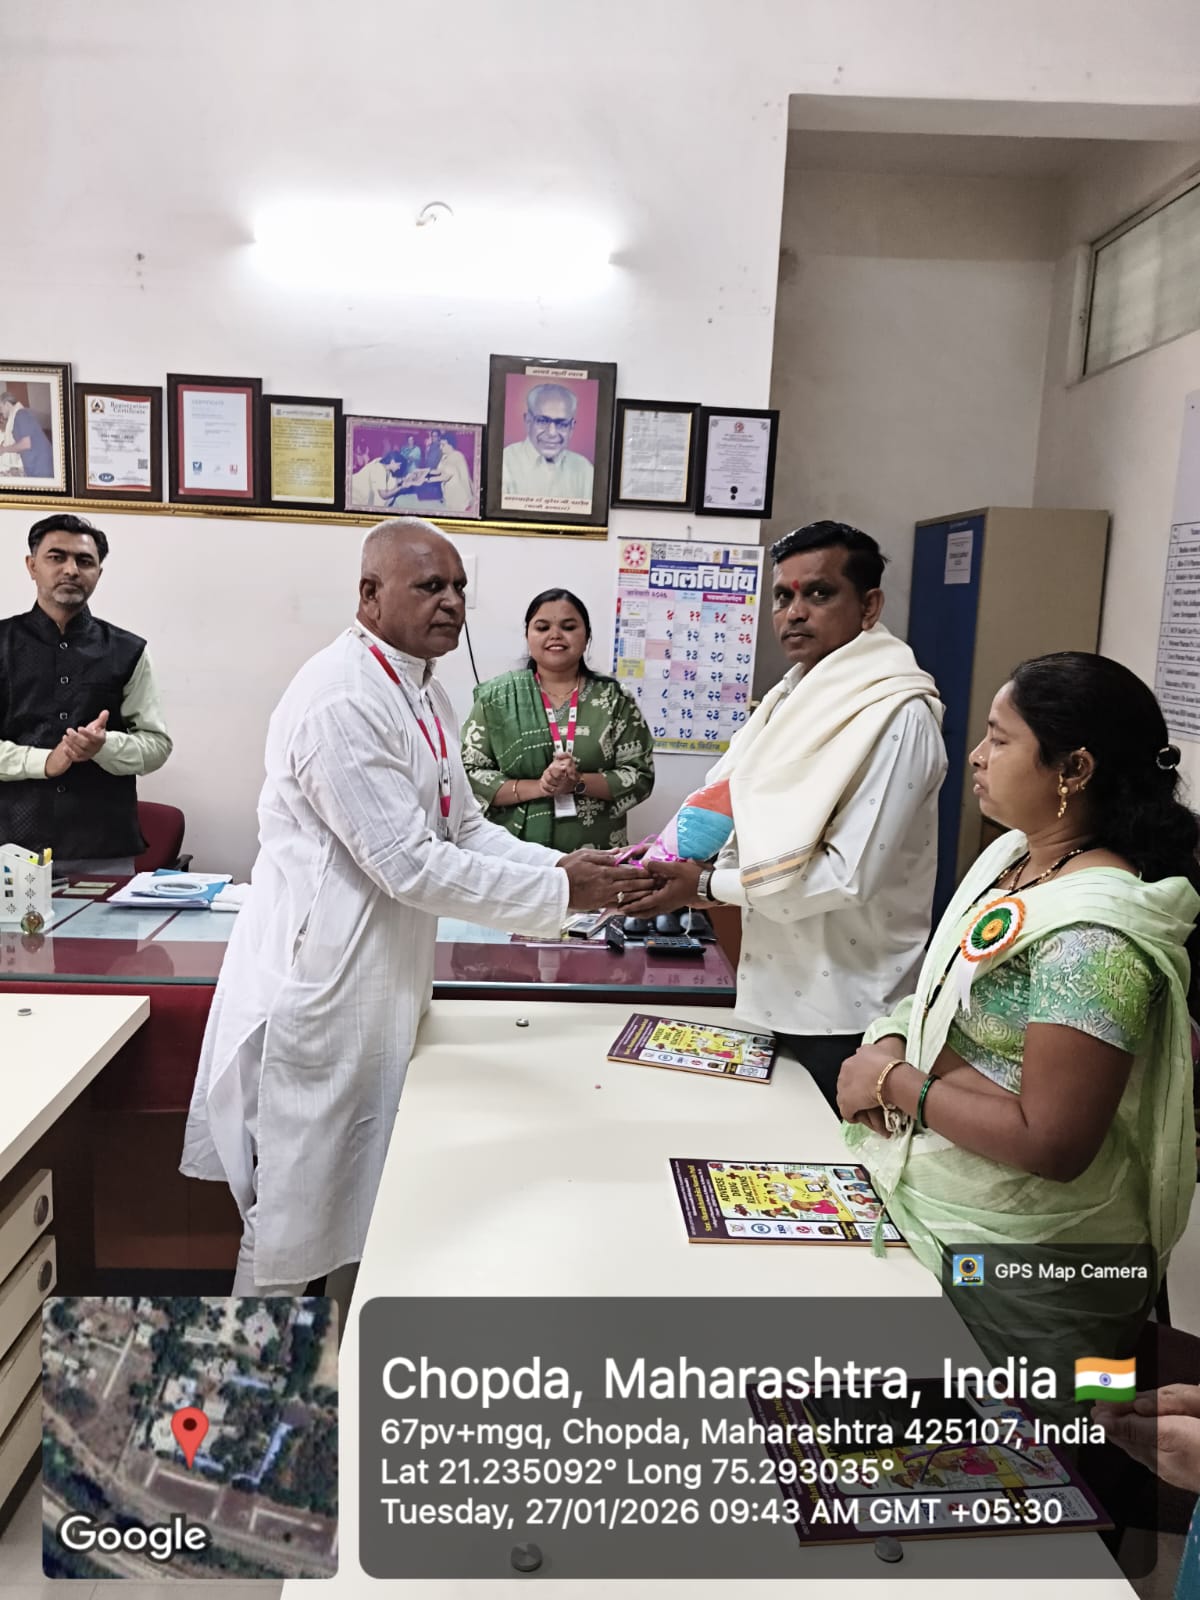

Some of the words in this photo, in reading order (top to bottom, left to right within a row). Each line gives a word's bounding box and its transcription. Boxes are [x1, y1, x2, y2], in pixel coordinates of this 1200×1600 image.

[651, 566, 756, 592] कालनिर्णय
[690, 611, 701, 621] ११
[714, 612, 726, 624] १८
[740, 614, 754, 624] २५
[688, 630, 699, 642] १२
[714, 632, 726, 643] १९
[738, 633, 752, 644] २६
[686, 650, 698, 660] १३
[710, 652, 724, 662] २०
[736, 653, 751, 664] २७
[684, 670, 697, 681] १४
[711, 672, 724, 682] २१
[736, 673, 748, 684] २८
[683, 690, 695, 700] १५
[708, 690, 721, 702] २२
[734, 692, 748, 703] २९
[682, 708, 693, 719] १६
[706, 710, 720, 720] २३
[732, 711, 746, 722] ३०
[654, 726, 666, 737] १०
[680, 728, 692, 738] १७
[704, 729, 718, 740] २४
[714, 1176, 730, 1202] ADVERSE
[728, 1182, 741, 1197] DRUG
[740, 1176, 756, 1204] REACTIONS
